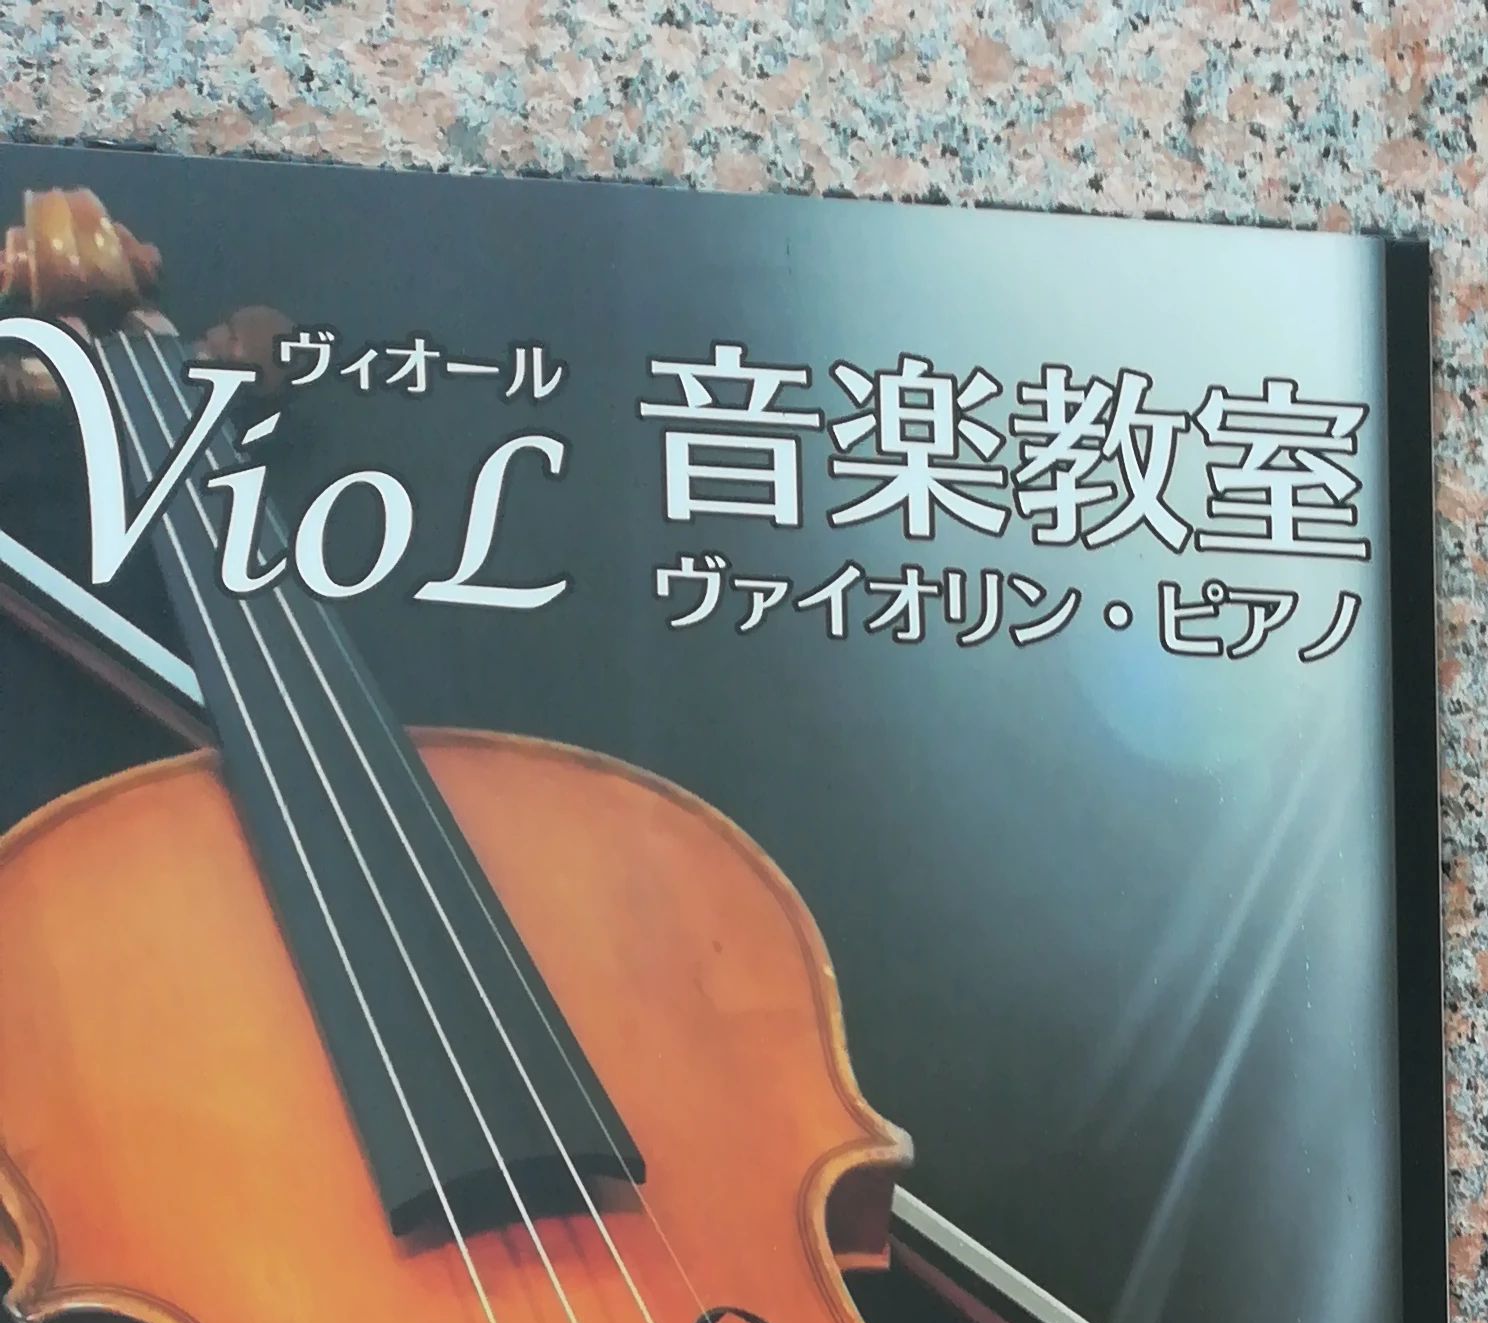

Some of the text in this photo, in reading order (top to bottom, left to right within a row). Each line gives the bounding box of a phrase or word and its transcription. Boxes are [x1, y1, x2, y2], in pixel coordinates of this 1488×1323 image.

[280, 330, 563, 399] ヴィオール
[639, 343, 1370, 560] 音楽教室
[655, 551, 1362, 662] ヴァイオリン・ピアノ
